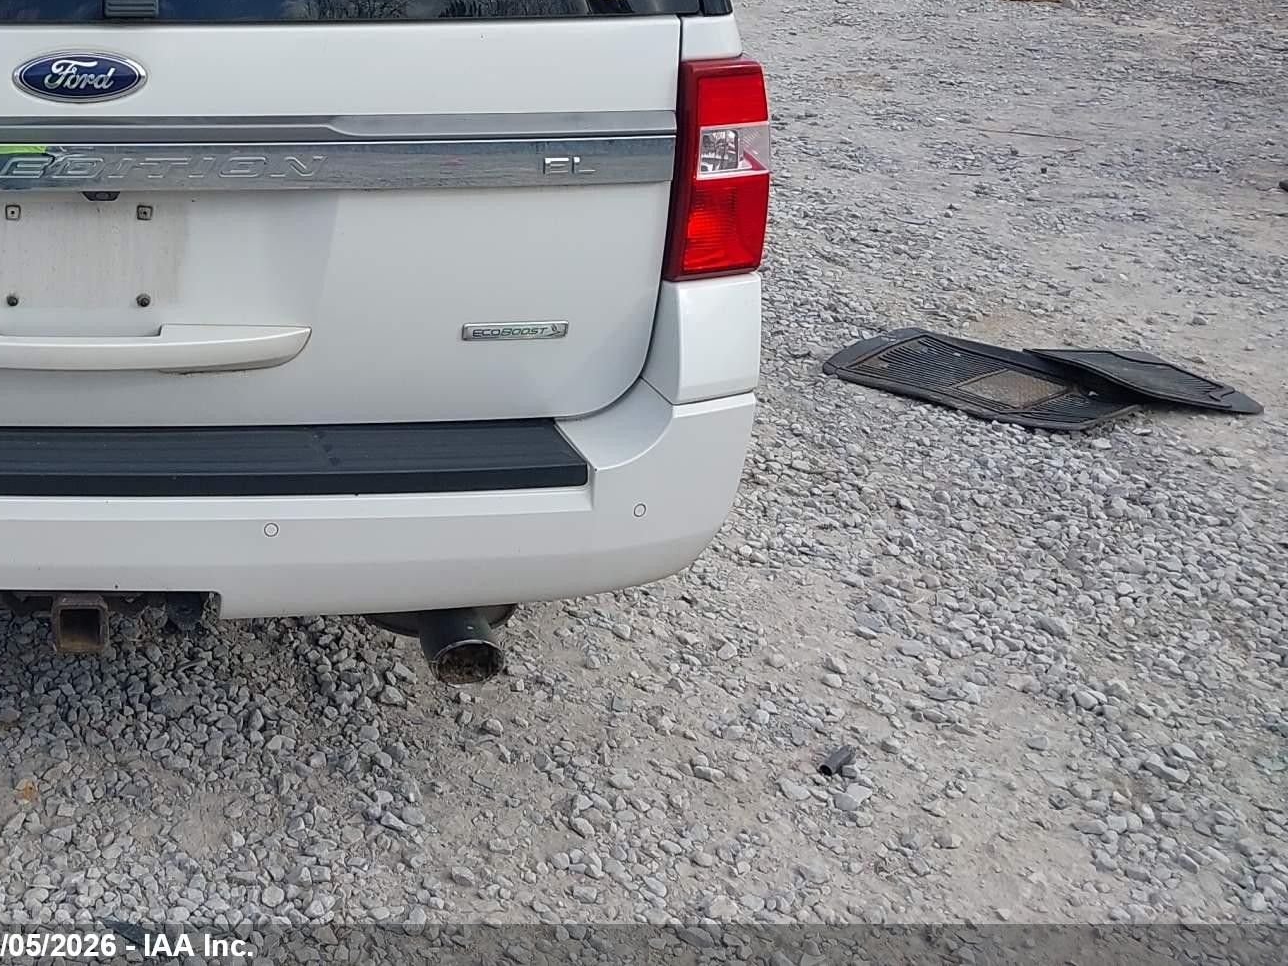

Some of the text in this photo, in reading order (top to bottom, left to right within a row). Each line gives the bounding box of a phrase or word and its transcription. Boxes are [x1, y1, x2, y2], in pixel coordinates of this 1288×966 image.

[44, 59, 116, 89] Ford
[543, 157, 596, 175] EL
[472, 327, 548, 338] ECOBOOST
